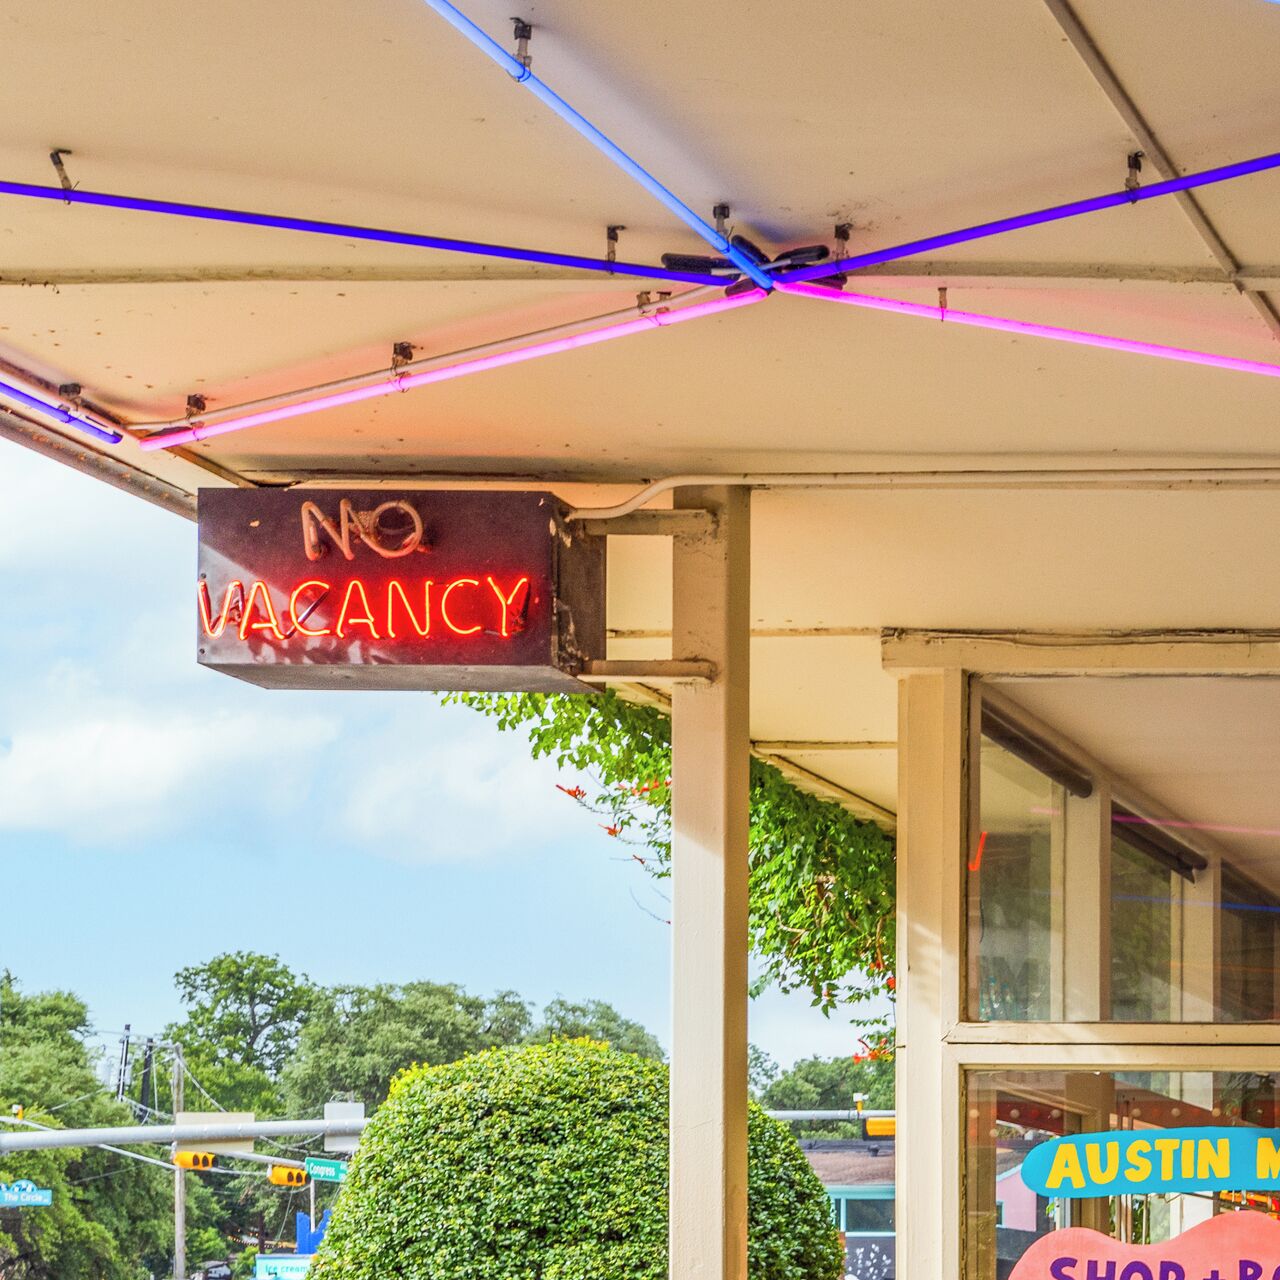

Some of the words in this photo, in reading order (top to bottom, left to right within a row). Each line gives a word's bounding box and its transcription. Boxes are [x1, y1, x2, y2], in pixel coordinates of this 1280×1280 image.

[301, 498, 424, 561] NO
[197, 576, 528, 640] VACANCY
[310, 1162, 336, 1178] Congress
[1044, 1137, 1231, 1189] AUSTIN
